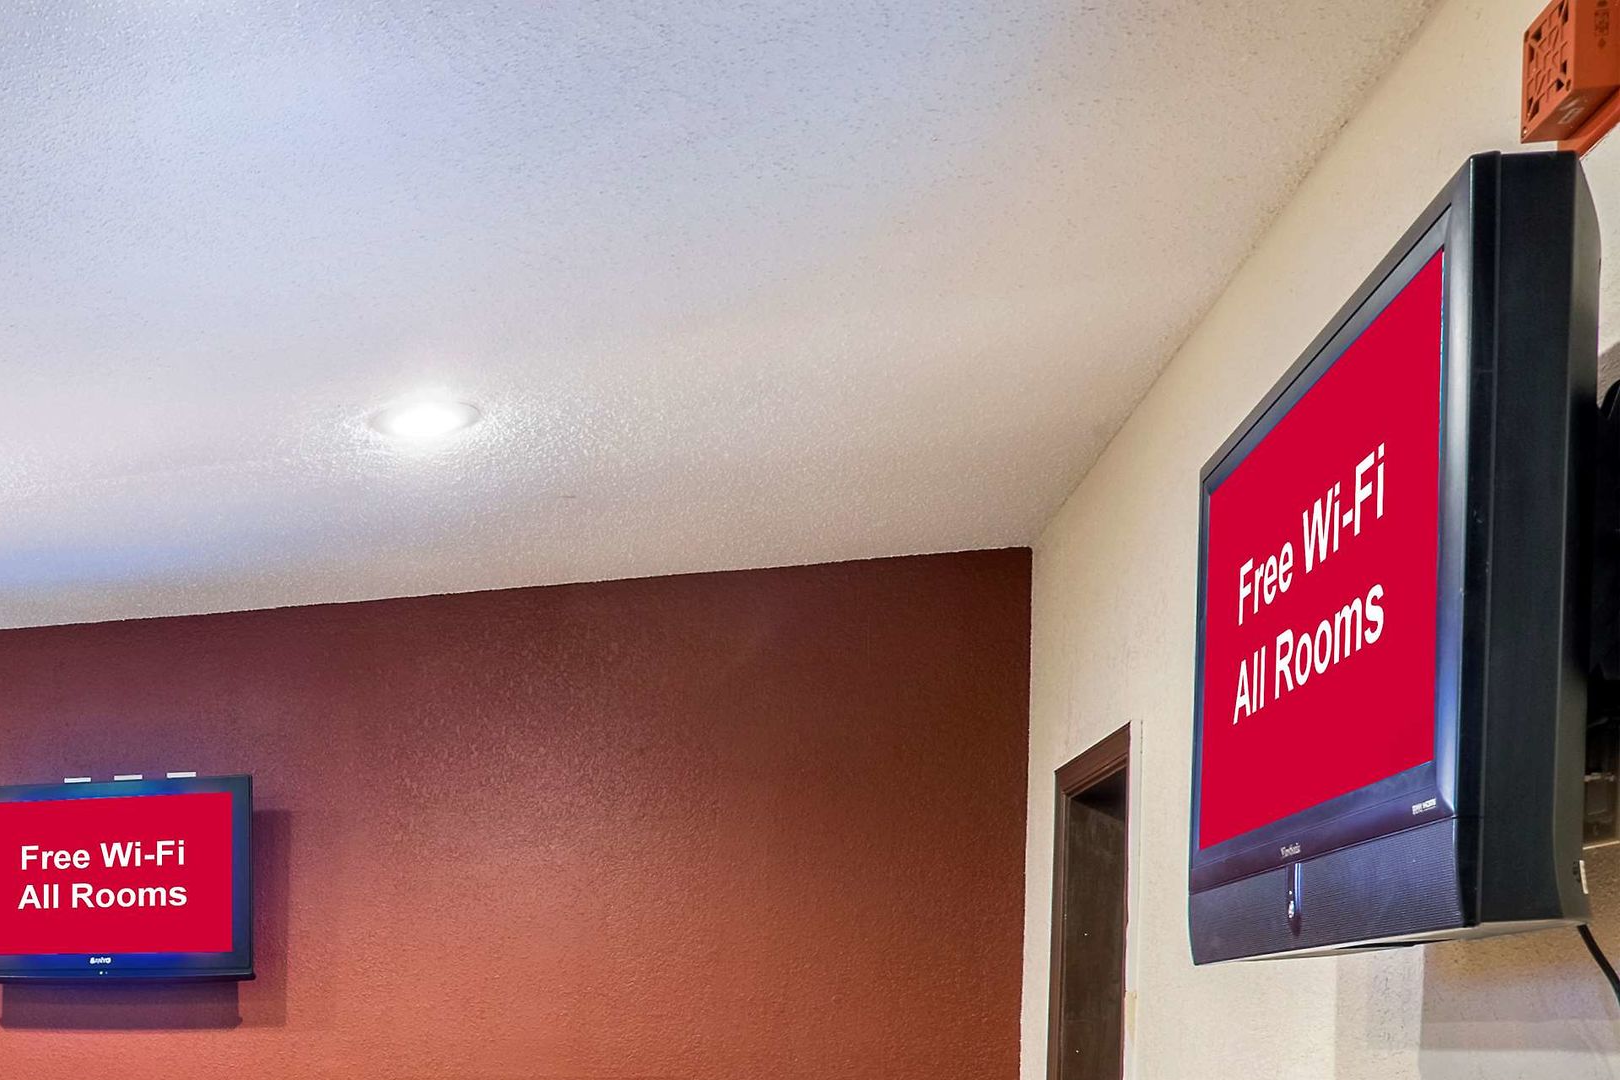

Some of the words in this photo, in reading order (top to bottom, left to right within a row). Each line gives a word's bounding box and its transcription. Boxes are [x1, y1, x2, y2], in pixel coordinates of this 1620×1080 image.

[1238, 541, 1294, 626] Free
[1302, 442, 1385, 574] Wi-Fi
[1232, 645, 1266, 725] All
[1274, 583, 1384, 700] Rooms
[17, 883, 59, 910] All
[71, 882, 188, 909] Rooms
[21, 845, 91, 871] Free
[99, 839, 185, 868] Wi-Fi
